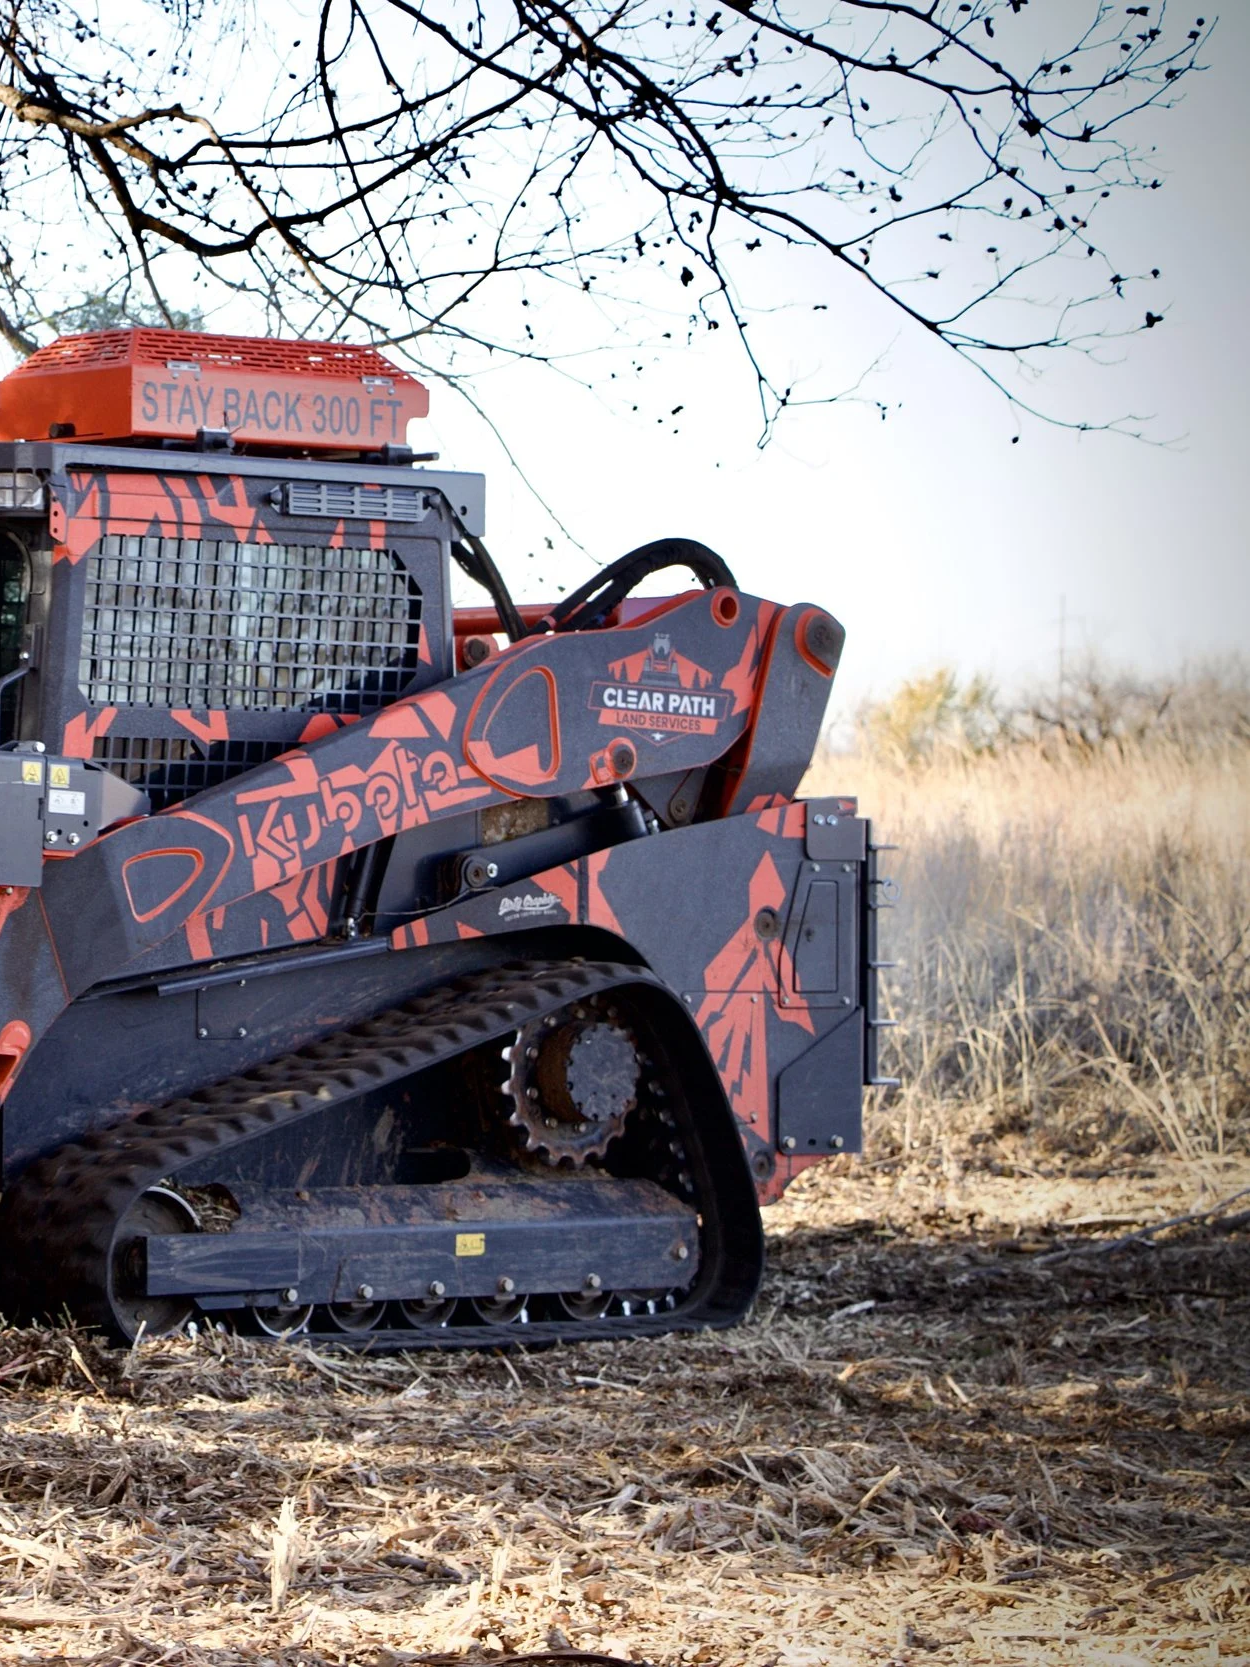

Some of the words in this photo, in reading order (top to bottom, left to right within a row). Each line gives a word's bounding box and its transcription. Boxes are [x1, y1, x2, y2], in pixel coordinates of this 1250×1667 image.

[141, 380, 214, 426] STAY
[222, 387, 303, 434] BACK
[311, 393, 361, 436] 300
[369, 398, 403, 439] FT
[603, 687, 664, 712] CLEAR
[668, 693, 716, 717] PATH
[616, 711, 647, 726] LAND
[648, 715, 702, 731] SERVICES
[237, 746, 459, 861] Kubota
